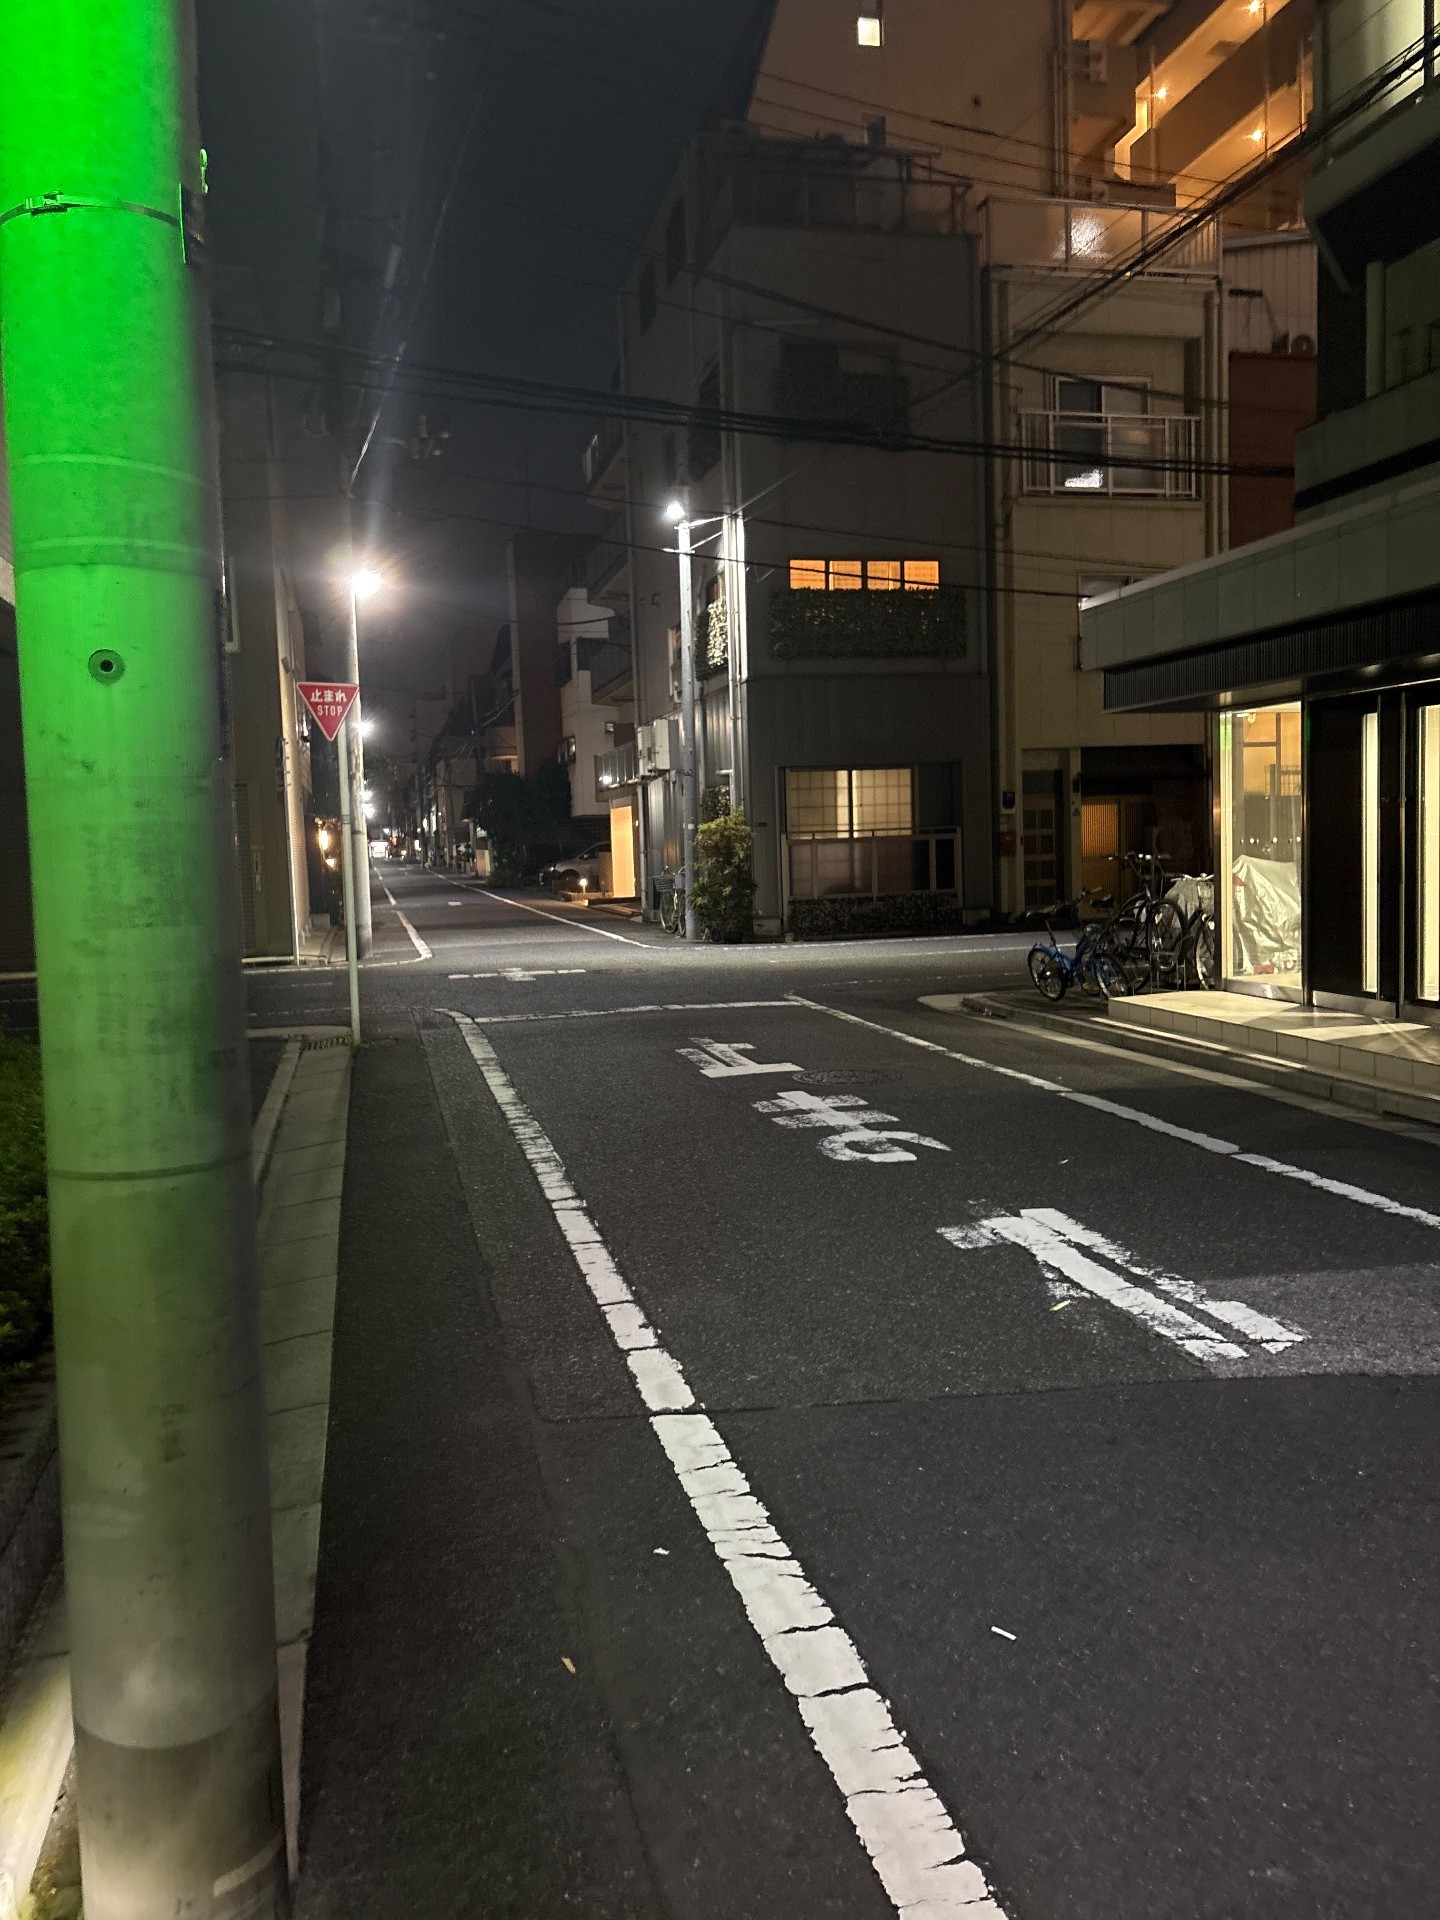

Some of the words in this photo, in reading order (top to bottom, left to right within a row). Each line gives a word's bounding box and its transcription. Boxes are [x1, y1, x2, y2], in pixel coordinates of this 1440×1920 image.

[310, 689, 347, 703] 止まれ
[317, 705, 343, 717] STOP
